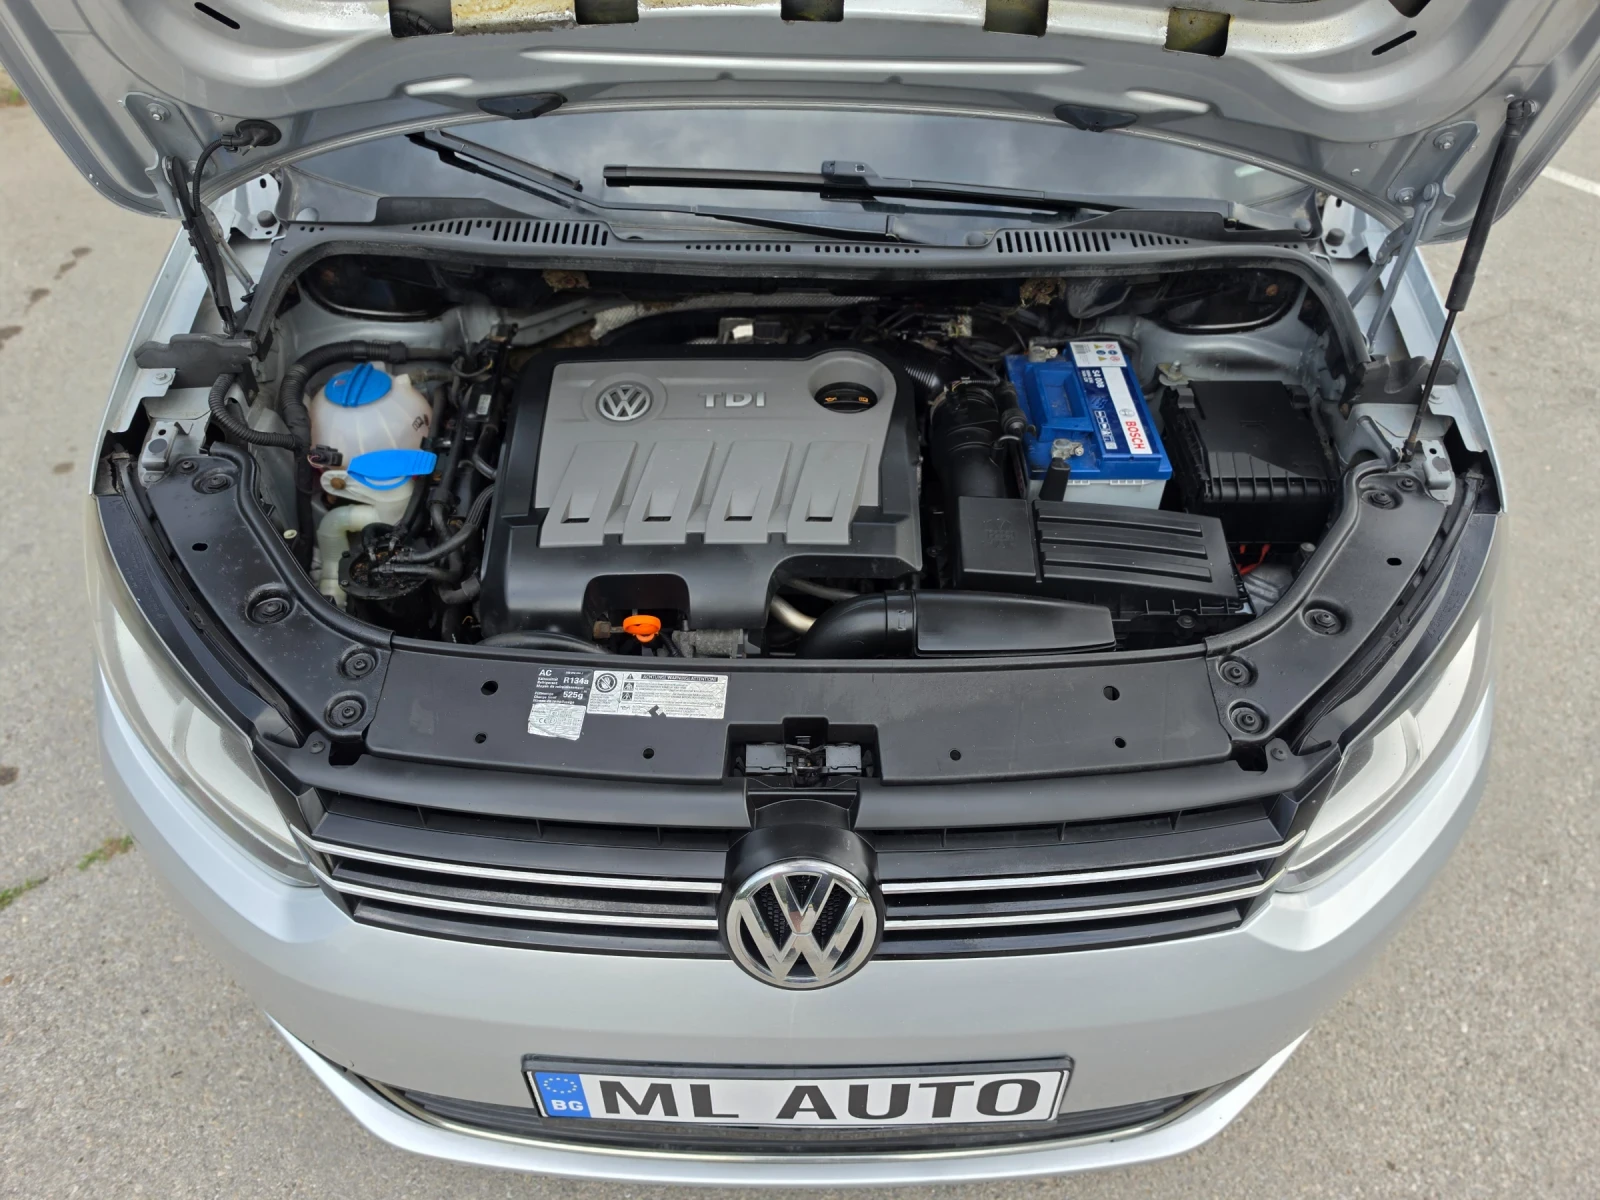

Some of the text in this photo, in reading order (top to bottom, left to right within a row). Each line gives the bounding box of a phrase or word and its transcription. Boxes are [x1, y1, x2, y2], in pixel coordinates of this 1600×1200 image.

[599, 384, 651, 421] VW
[699, 391, 766, 408] TDI
[1125, 421, 1145, 450] BOSCH
[563, 691, 584, 700] 525g
[726, 861, 877, 987] VW
[550, 1099, 584, 1112] BG
[599, 1078, 1042, 1120] ML AUTO
